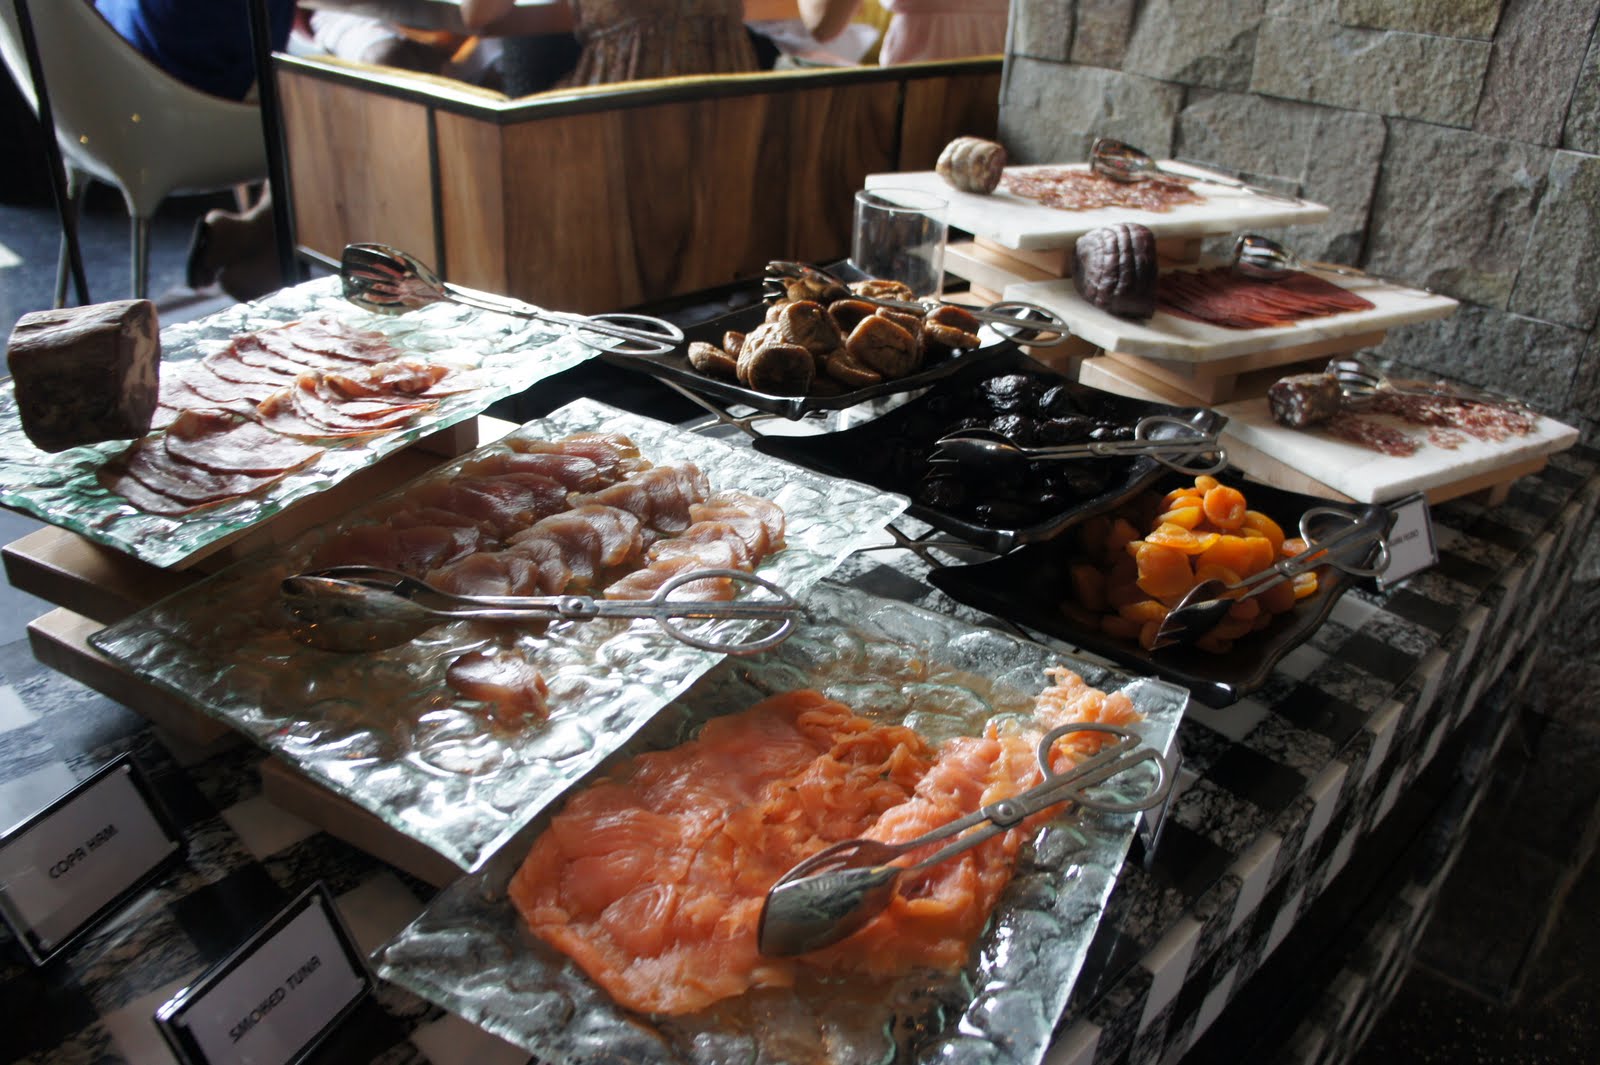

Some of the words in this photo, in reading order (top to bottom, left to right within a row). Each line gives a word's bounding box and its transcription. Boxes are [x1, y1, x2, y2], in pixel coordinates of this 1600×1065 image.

[49, 847, 87, 879] COPA
[86, 824, 118, 852] HAM
[229, 986, 286, 1044] SMOKED
[286, 955, 322, 990] TUNA
